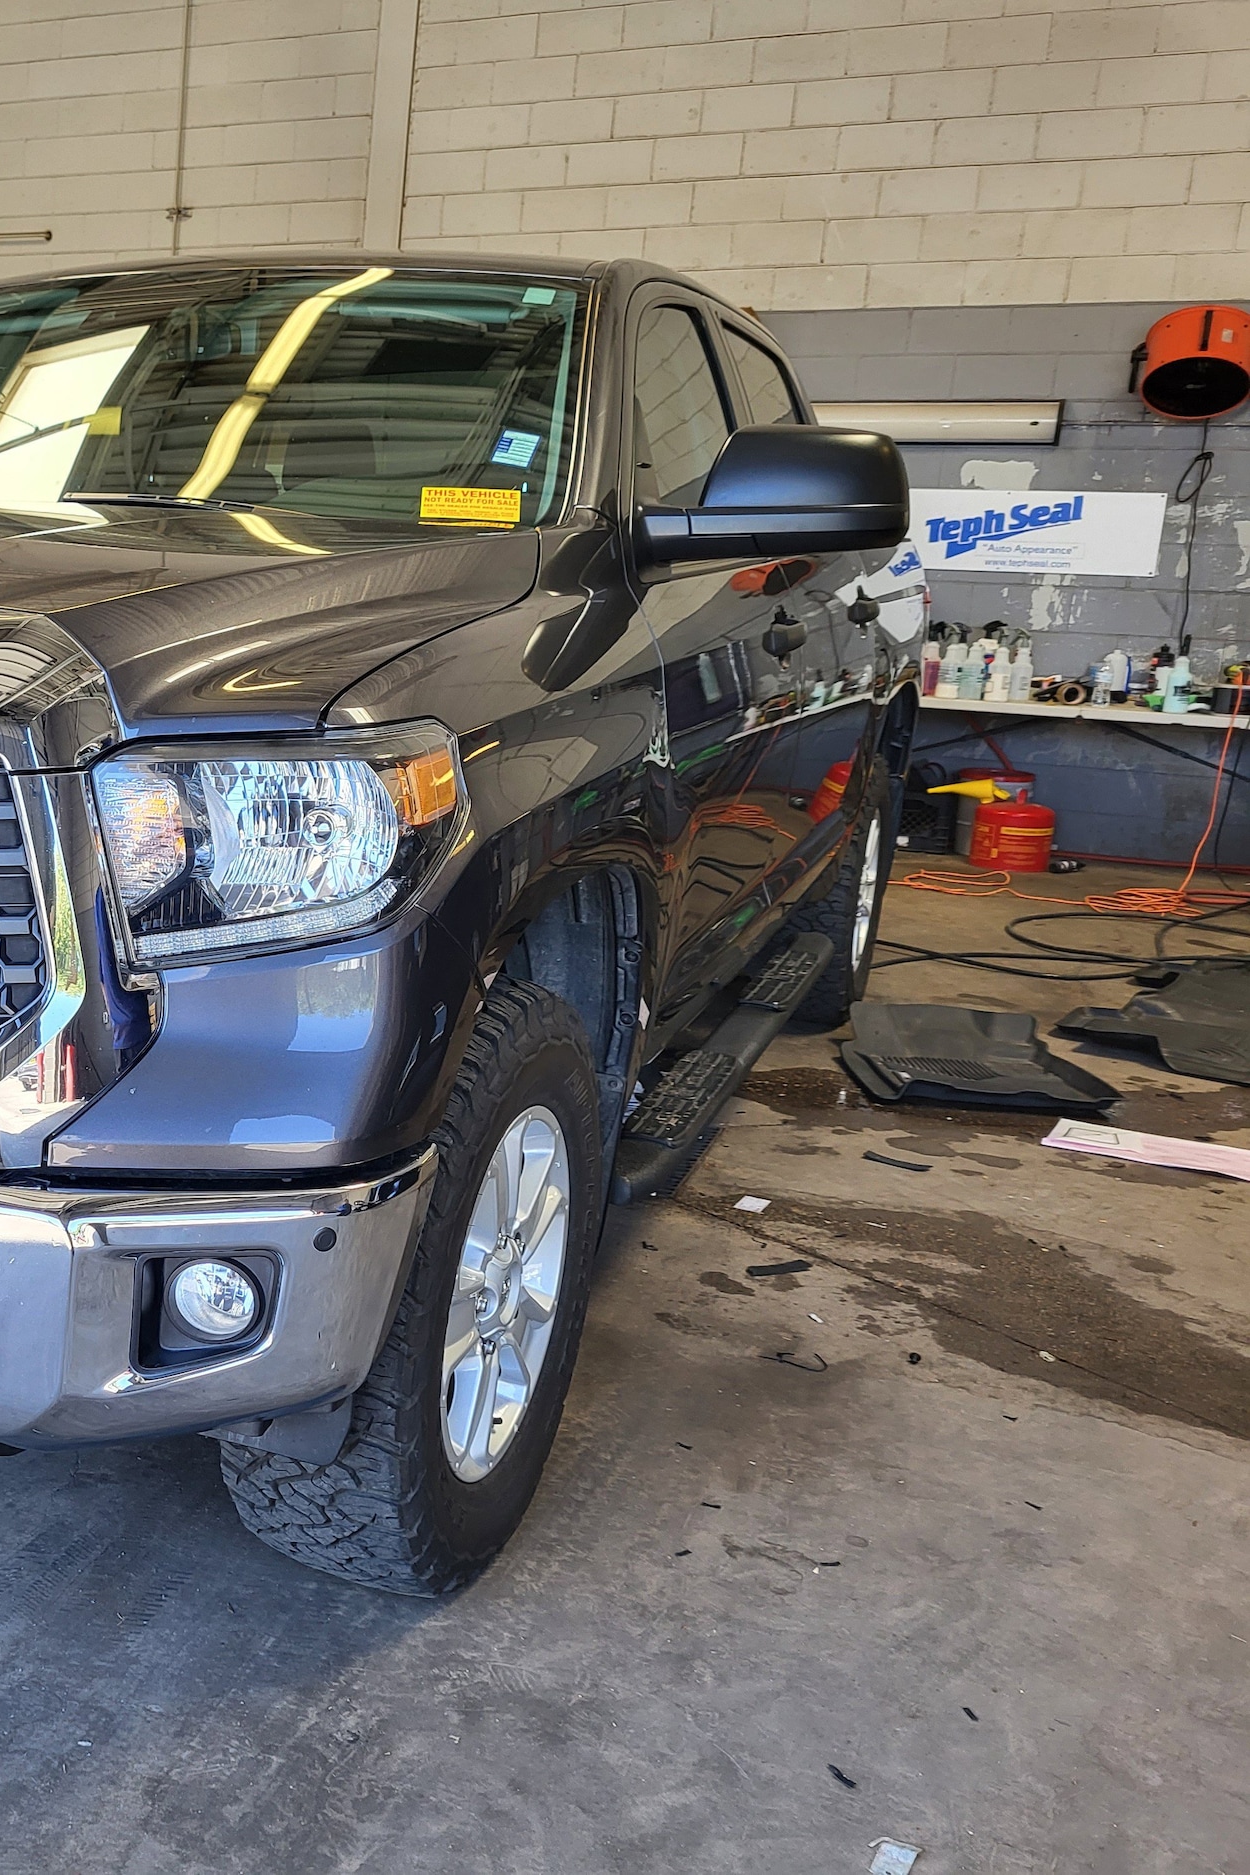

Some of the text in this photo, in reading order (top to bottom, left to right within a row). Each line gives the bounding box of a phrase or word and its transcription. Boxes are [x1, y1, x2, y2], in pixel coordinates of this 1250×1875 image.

[426, 489, 518, 500] THIS VEHICLE
[926, 495, 1084, 543] Teph Seal
[982, 543, 1078, 555] "Auto Appearance"
[984, 559, 1071, 568] www.tephseal.com
